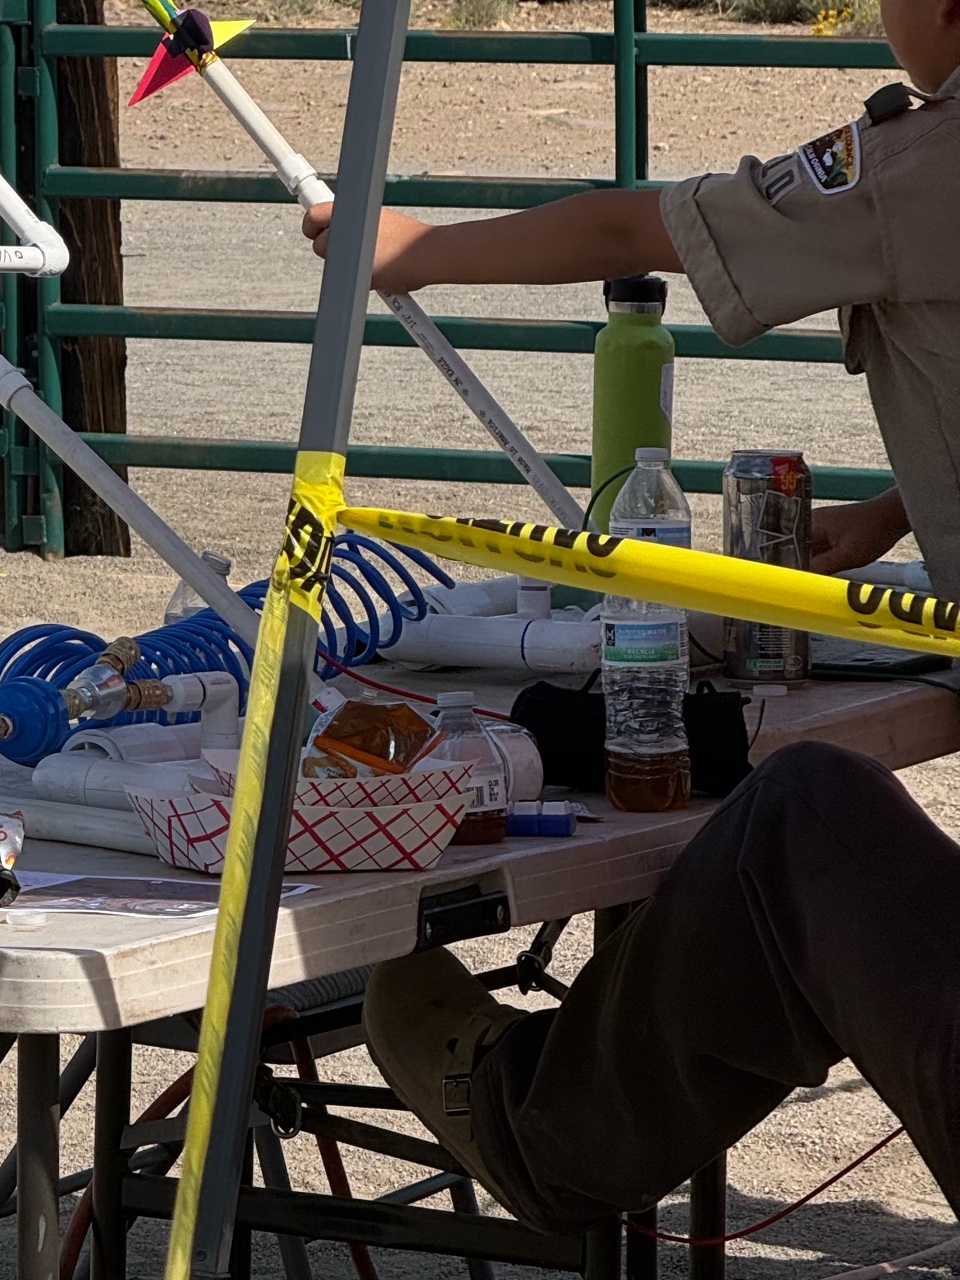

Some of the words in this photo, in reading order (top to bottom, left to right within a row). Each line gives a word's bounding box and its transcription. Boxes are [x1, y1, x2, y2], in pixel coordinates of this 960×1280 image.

[438, 356, 455, 378] EAGLE
[487, 418, 510, 446] America
[517, 456, 532, 474] Made
